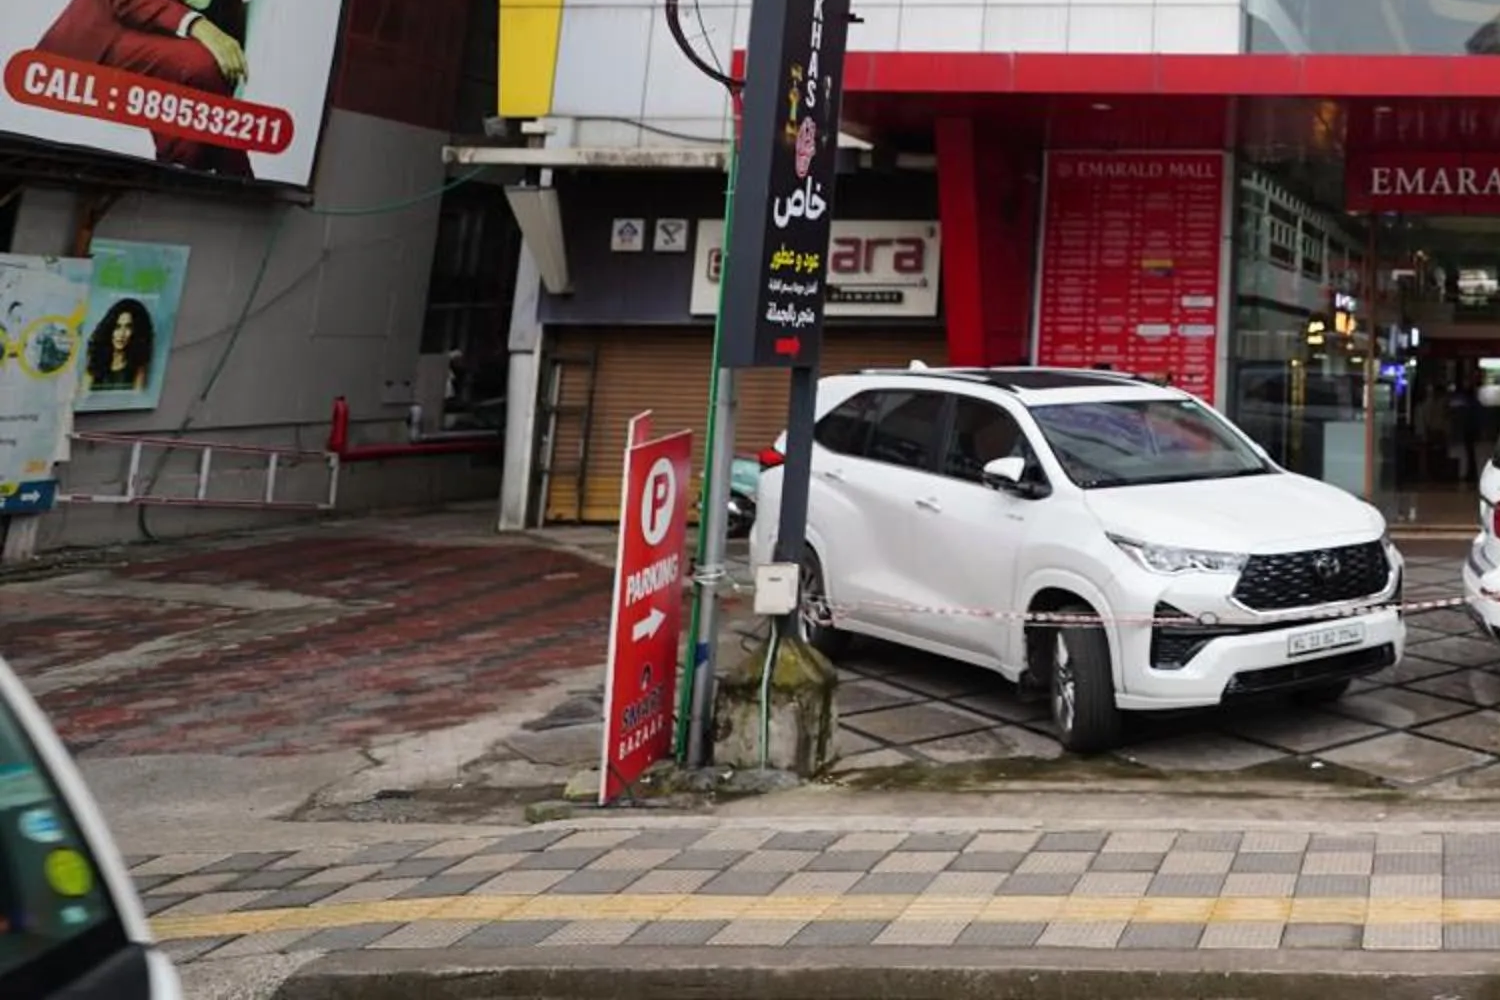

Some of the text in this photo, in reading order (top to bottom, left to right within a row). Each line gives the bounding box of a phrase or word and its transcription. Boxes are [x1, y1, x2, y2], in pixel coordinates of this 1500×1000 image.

[24, 62, 99, 106] CALL
[126, 84, 283, 146] 9895332211
[1077, 161, 1215, 178] EMARALD MALL
[773, 176, 827, 228] خاص
[830, 237, 925, 275] ara
[649, 471, 669, 531] P
[625, 554, 680, 607] PARKING
